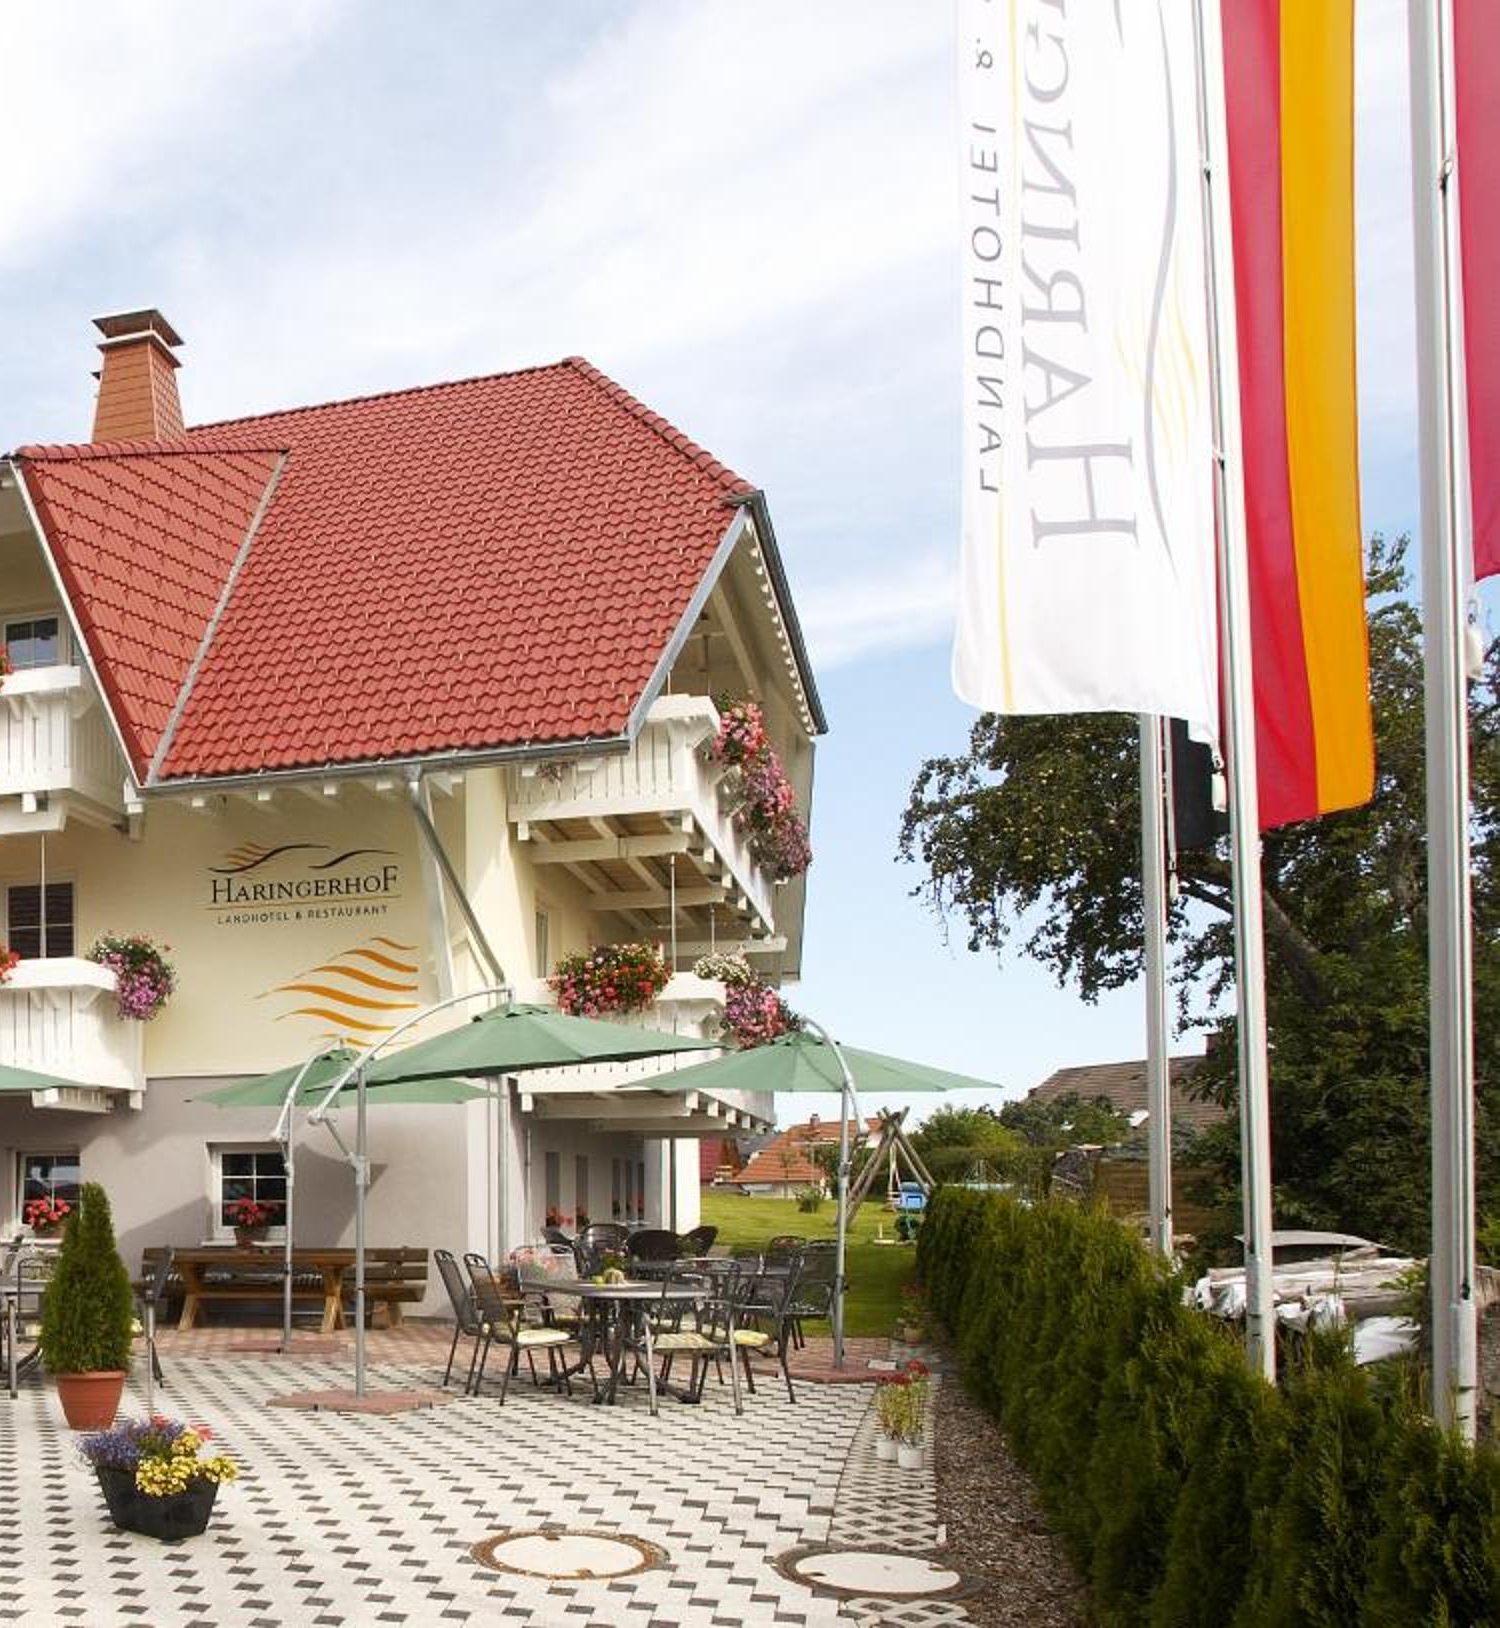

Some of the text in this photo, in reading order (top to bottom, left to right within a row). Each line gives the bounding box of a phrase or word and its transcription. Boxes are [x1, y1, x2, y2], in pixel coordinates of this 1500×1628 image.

[211, 865, 398, 904] HARINGERHOF
[217, 905, 389, 925] LANDHOTEL & RESTAURANT
